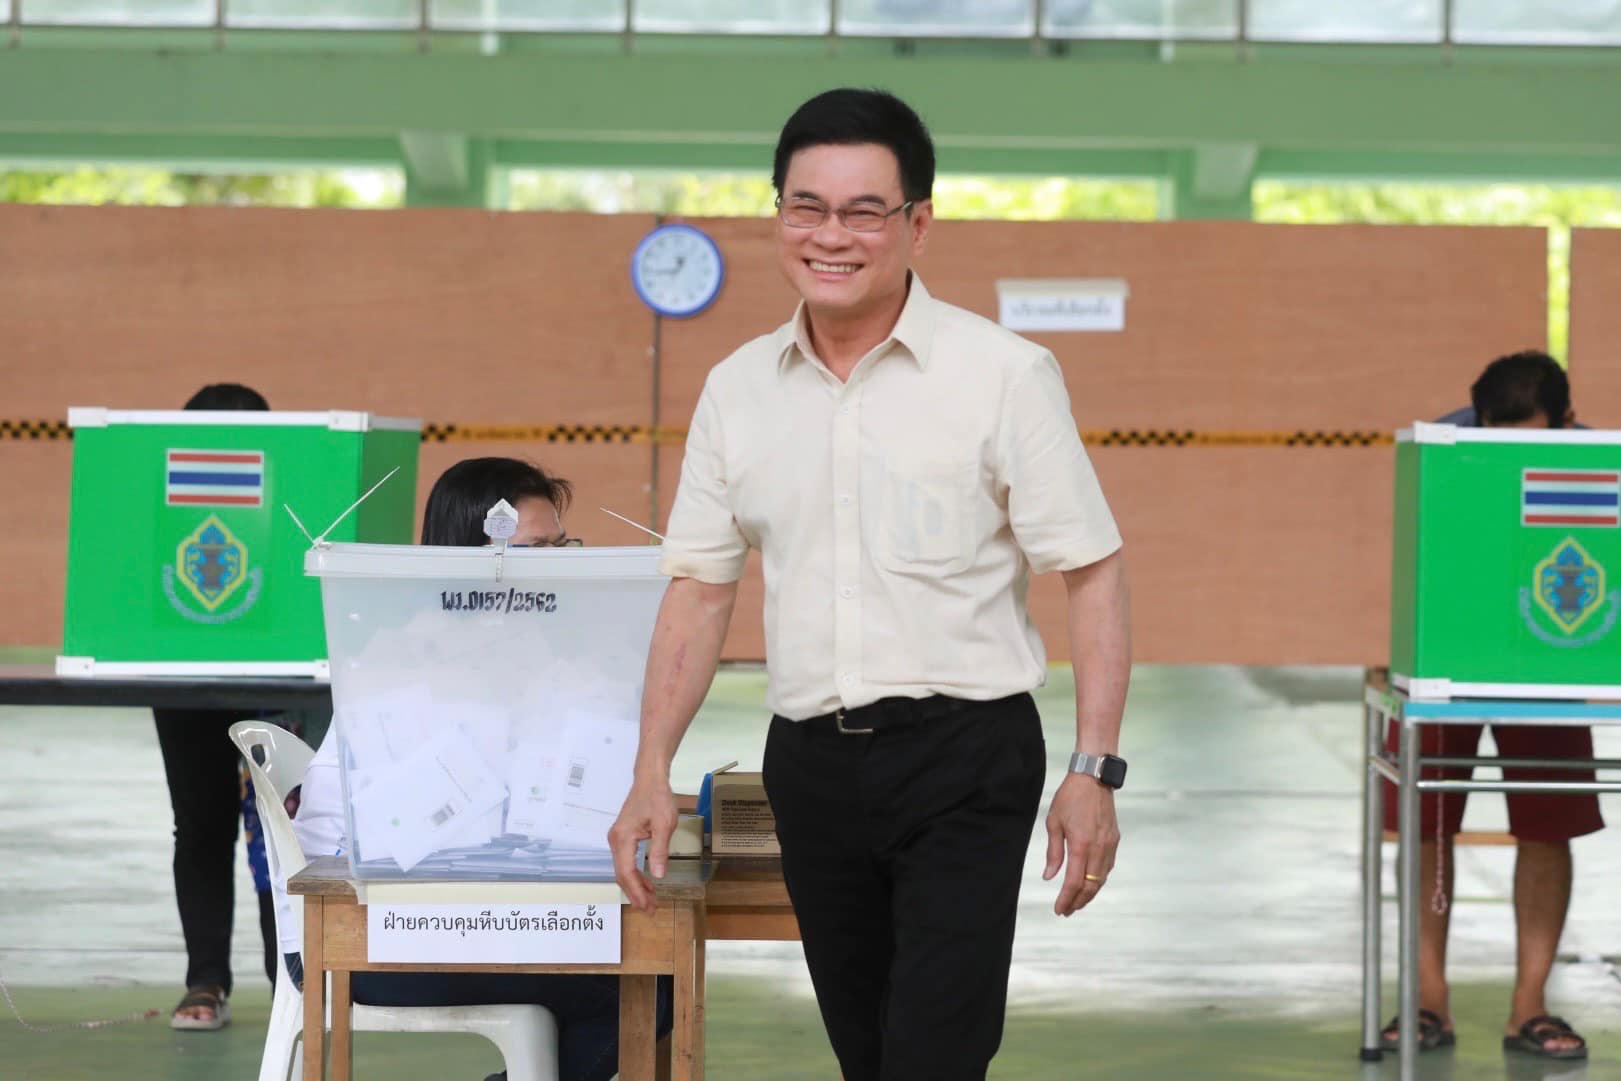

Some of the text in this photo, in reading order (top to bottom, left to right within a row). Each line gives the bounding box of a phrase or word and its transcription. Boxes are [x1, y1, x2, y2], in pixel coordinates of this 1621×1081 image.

[384, 905, 604, 937] ฝ่ายควบคุมหีบบัตรเลือกตั้ง
